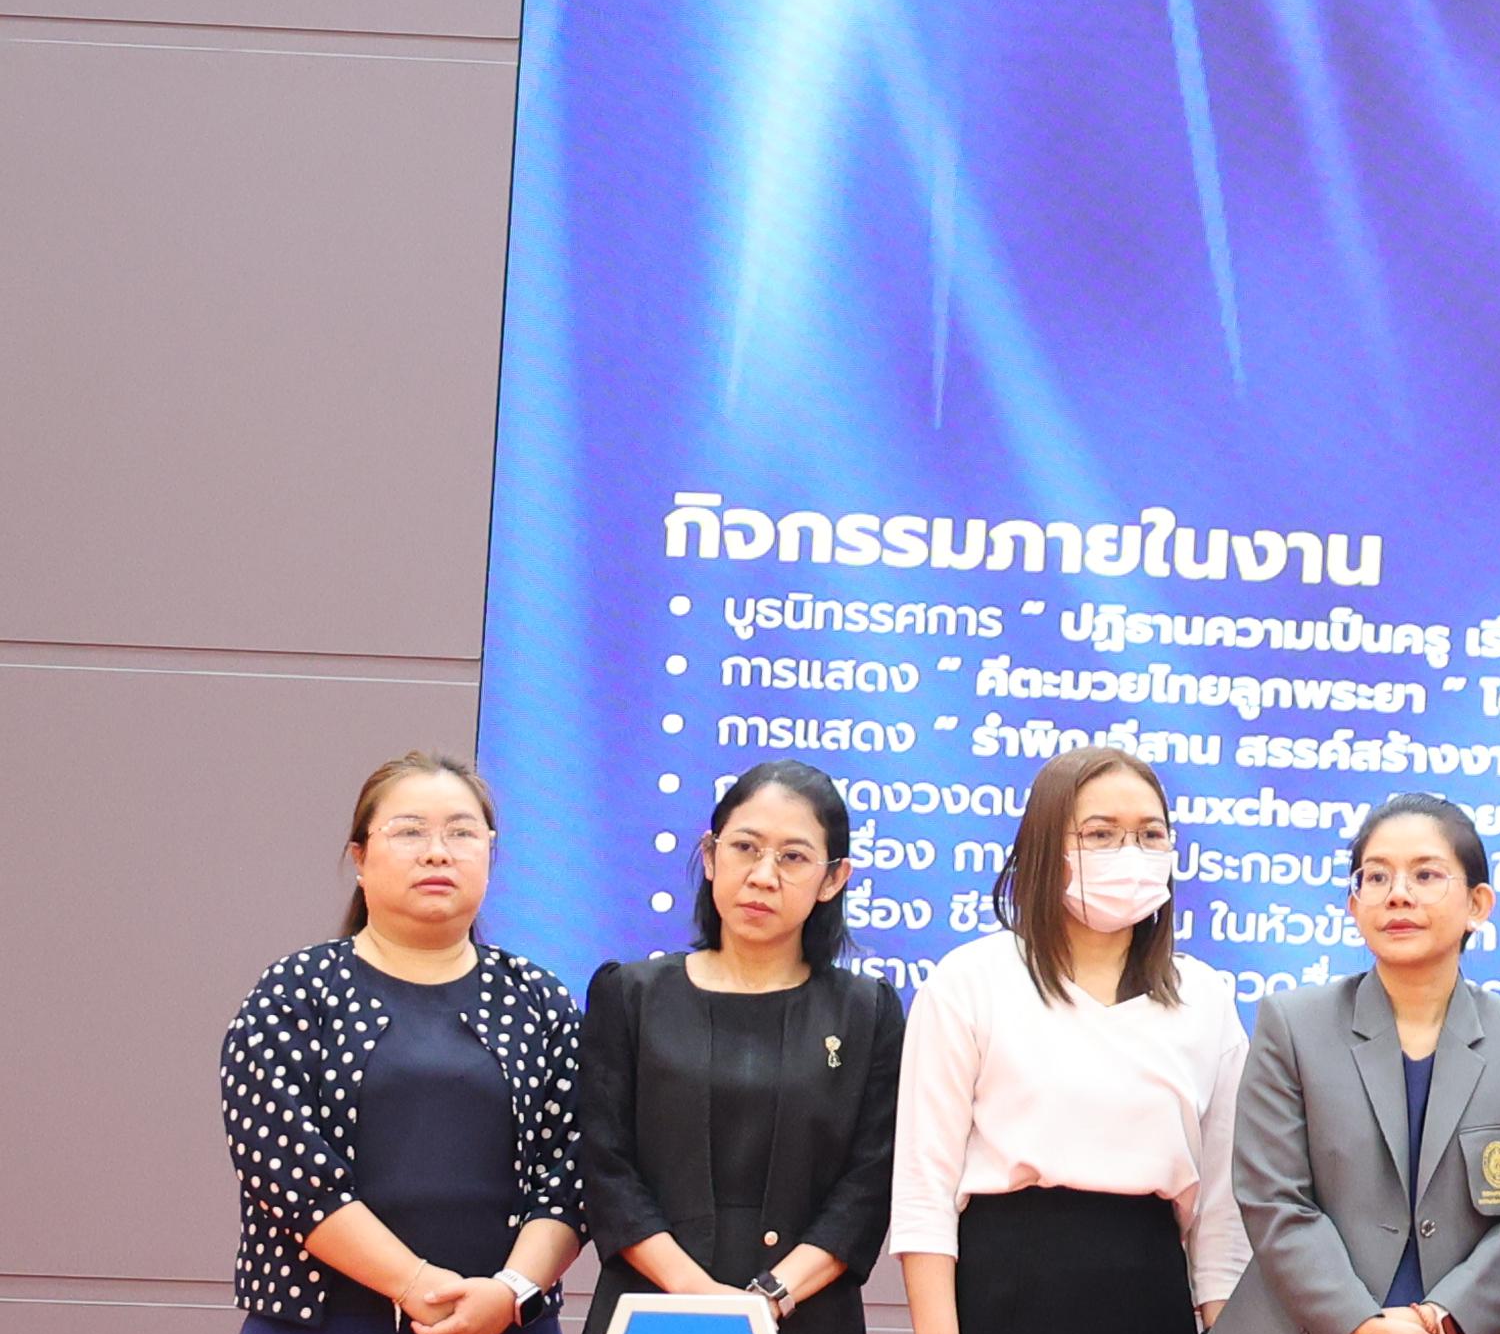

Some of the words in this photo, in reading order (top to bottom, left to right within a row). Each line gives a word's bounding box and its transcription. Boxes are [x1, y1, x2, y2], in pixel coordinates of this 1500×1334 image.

[664, 492, 1384, 587] กิจกรรมภายในงาน
[723, 592, 1004, 641] บูธนิทรรศการ
[720, 654, 920, 693] การแสดง
[717, 714, 917, 752] การแสดง
